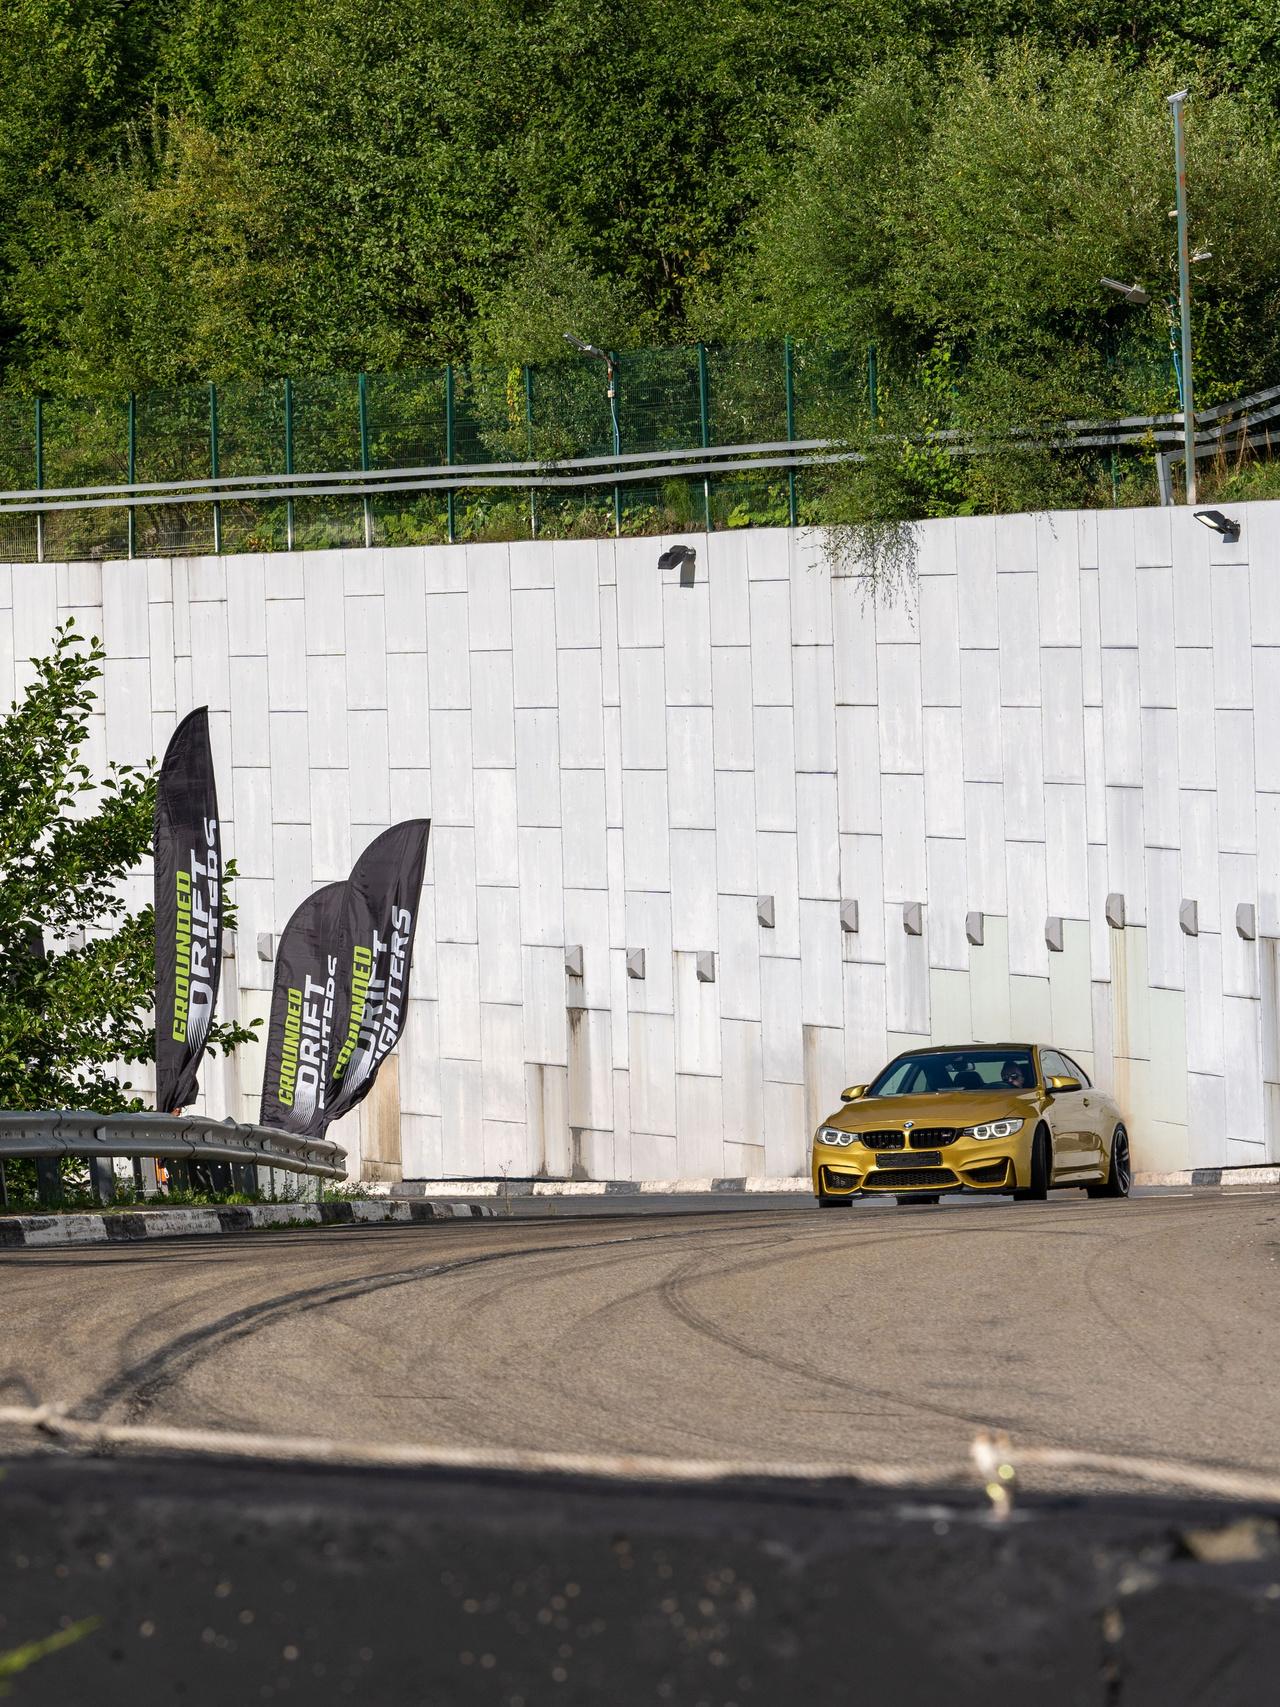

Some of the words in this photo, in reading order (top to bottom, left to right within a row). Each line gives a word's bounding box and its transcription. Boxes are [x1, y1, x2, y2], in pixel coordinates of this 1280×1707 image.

[172, 870, 192, 1043] GROUNDED
[188, 849, 214, 1021] DRIFT
[278, 988, 303, 1106] GROUNDED
[295, 974, 325, 1093] DRIFT
